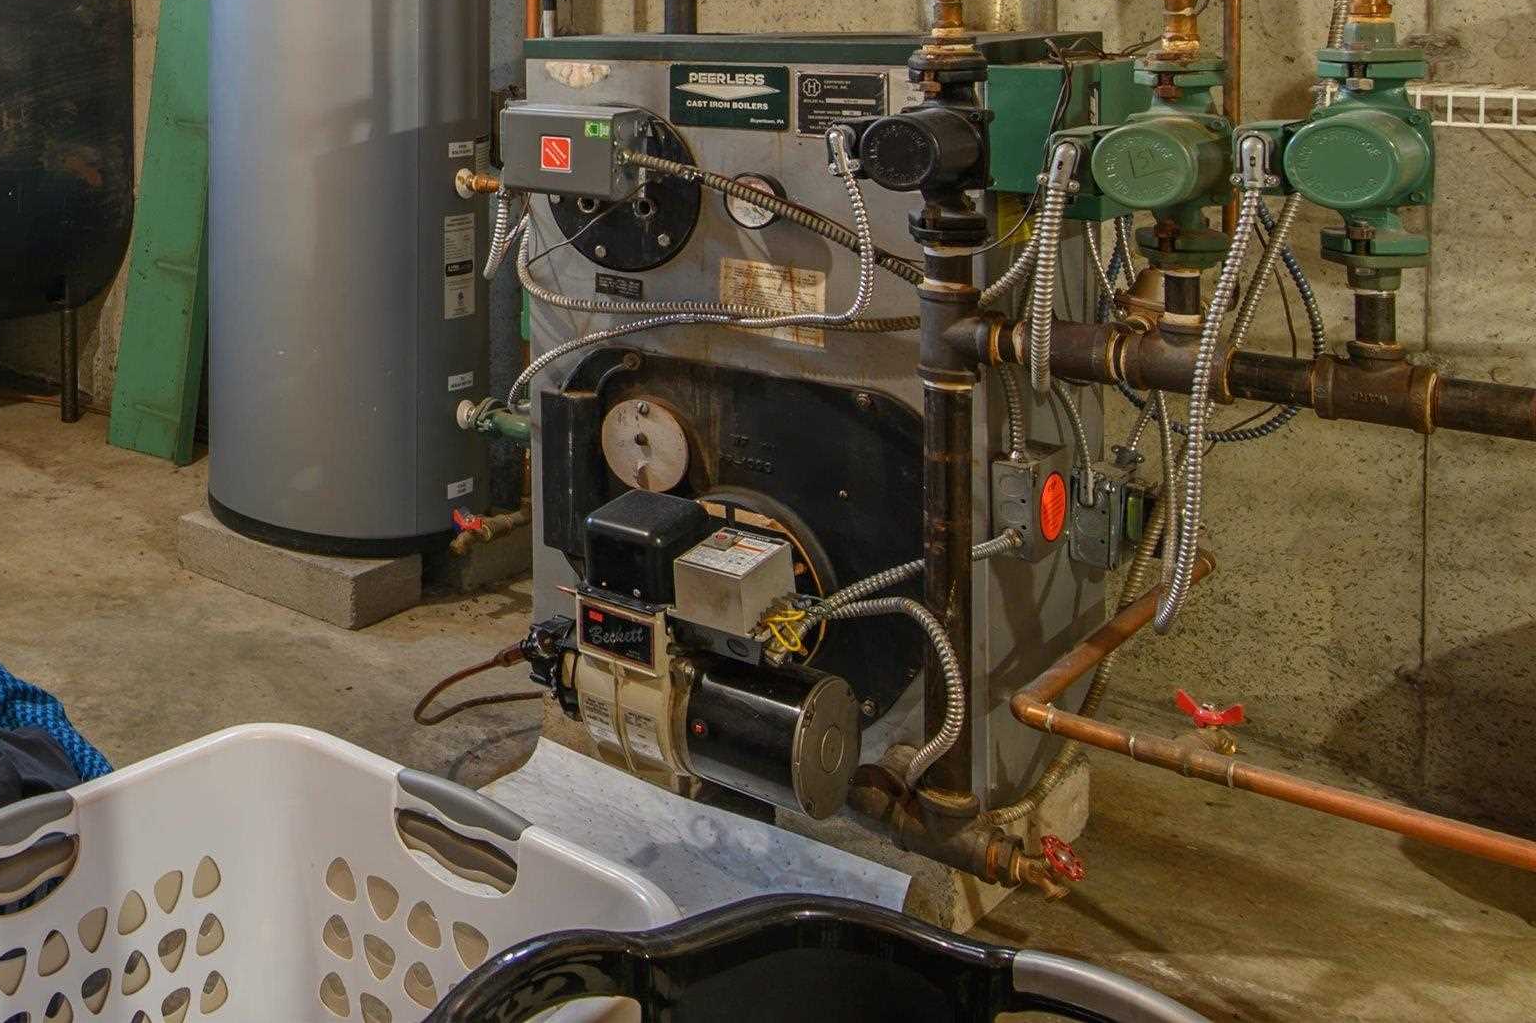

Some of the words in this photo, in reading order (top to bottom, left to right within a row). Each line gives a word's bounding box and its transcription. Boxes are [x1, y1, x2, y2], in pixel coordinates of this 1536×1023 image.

[689, 71, 765, 86] PEERLESS
[685, 100, 709, 109] CAST
[709, 100, 731, 109] IRON
[732, 101, 769, 111] BOILERS
